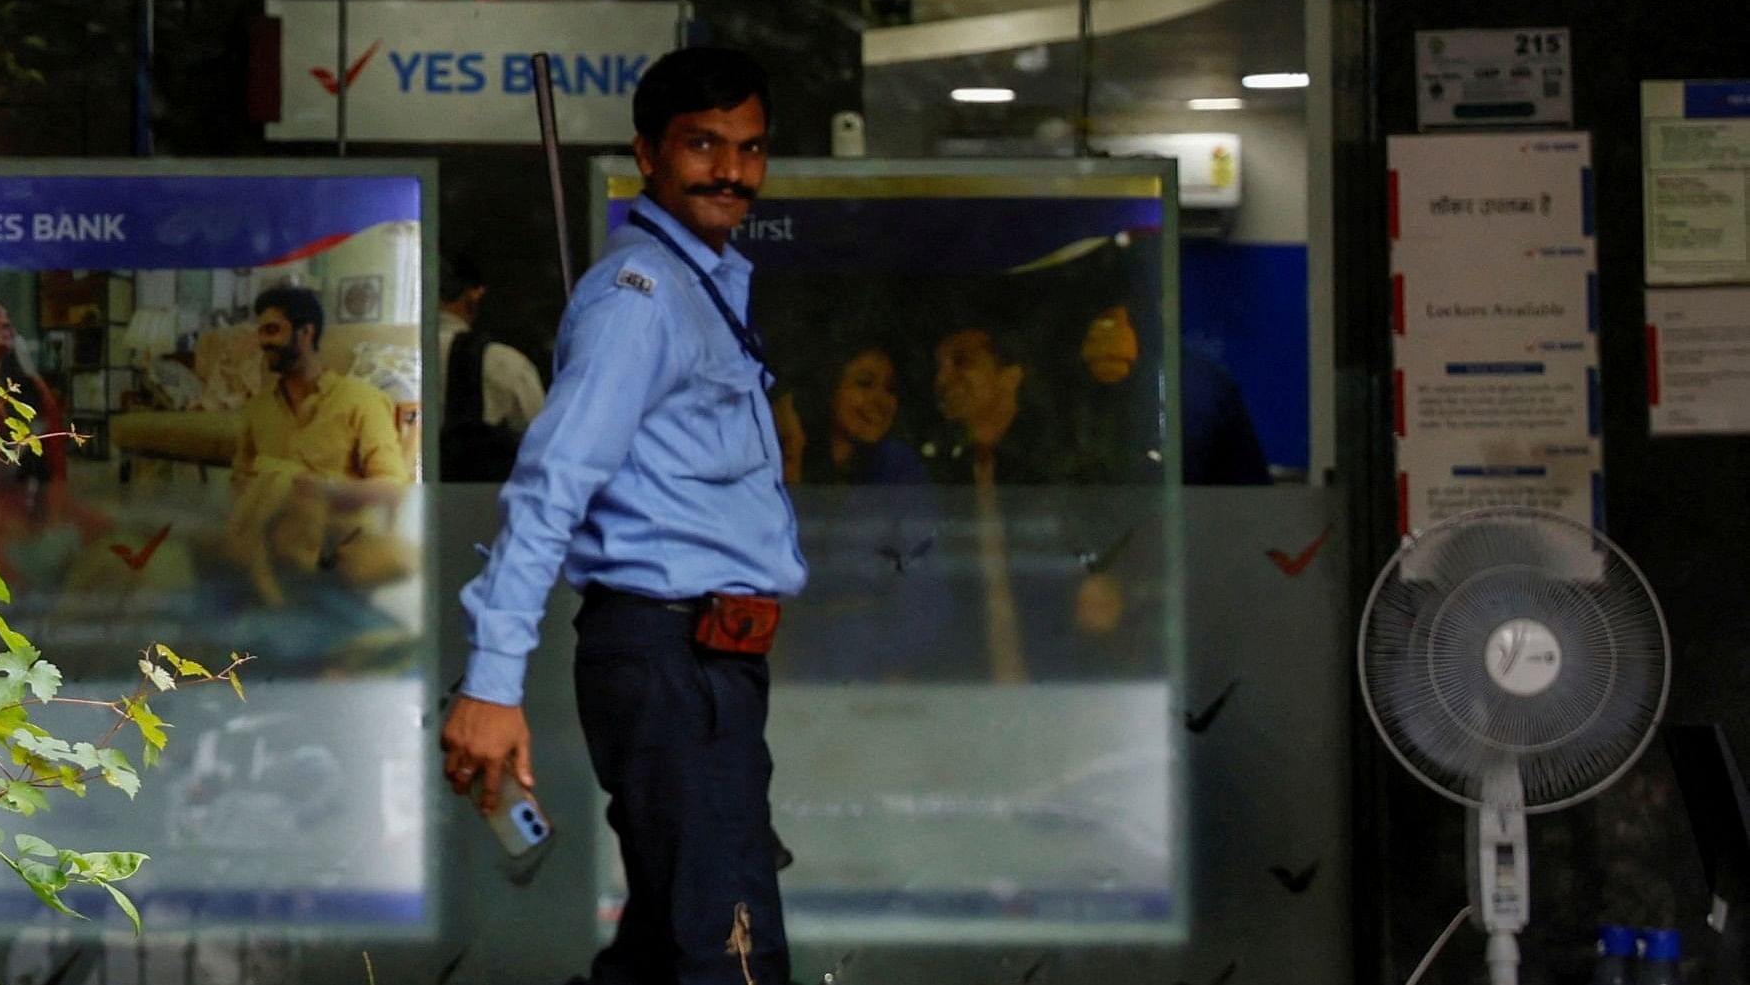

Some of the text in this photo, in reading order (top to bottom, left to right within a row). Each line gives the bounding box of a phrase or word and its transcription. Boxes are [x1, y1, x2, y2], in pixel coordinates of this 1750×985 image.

[1514, 33, 1561, 56] 215
[388, 52, 650, 95] YES BANK
[33, 212, 125, 241] BANK
